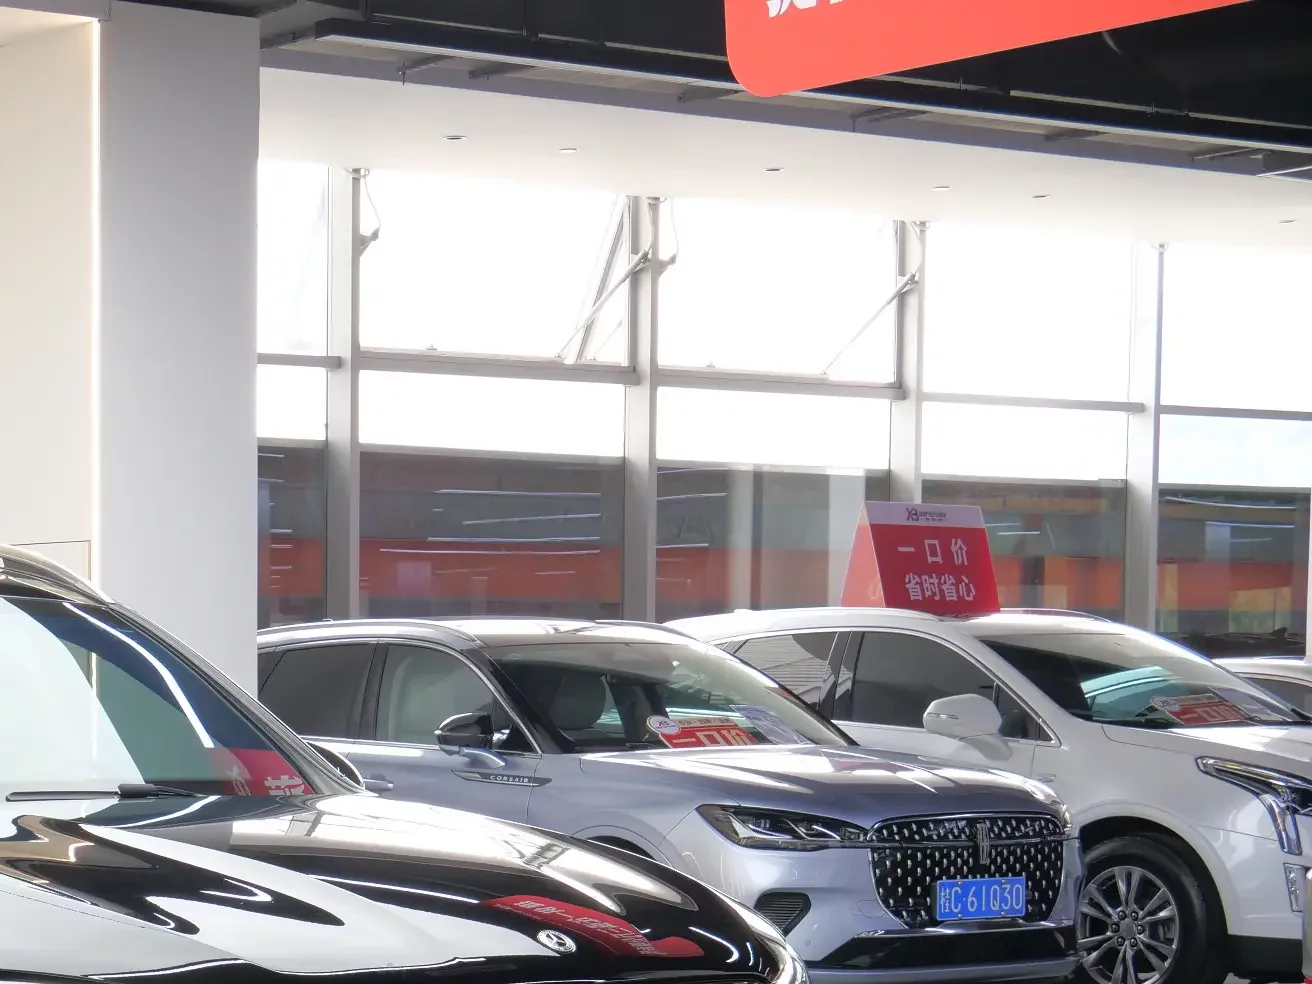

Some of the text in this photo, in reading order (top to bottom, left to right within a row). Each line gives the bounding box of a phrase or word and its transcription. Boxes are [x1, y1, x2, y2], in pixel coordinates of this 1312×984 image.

[897, 538, 968, 566] 一口价
[904, 572, 976, 602] 省时省心
[490, 775, 529, 783] CORSAIR
